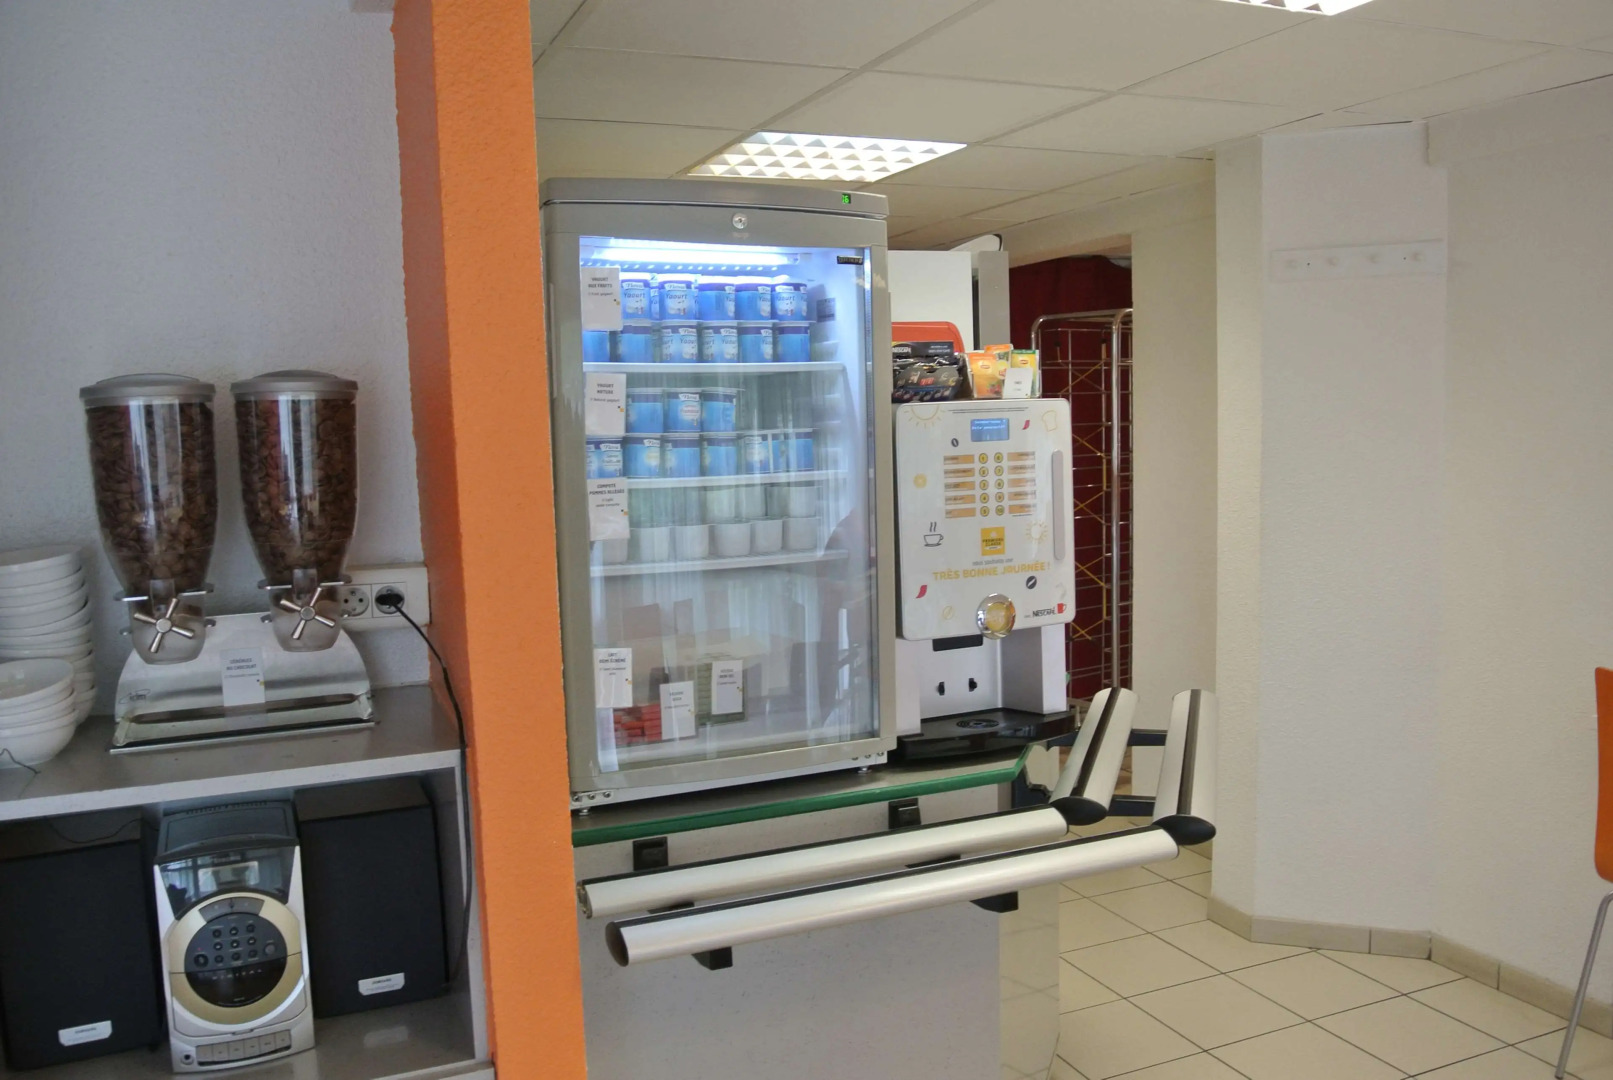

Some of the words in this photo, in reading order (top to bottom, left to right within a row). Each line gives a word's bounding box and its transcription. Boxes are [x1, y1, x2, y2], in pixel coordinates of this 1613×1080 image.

[932, 568, 960, 581] TRÈS
[962, 567, 998, 579] BONNE
[1001, 561, 1046, 574] JOURNÉE
